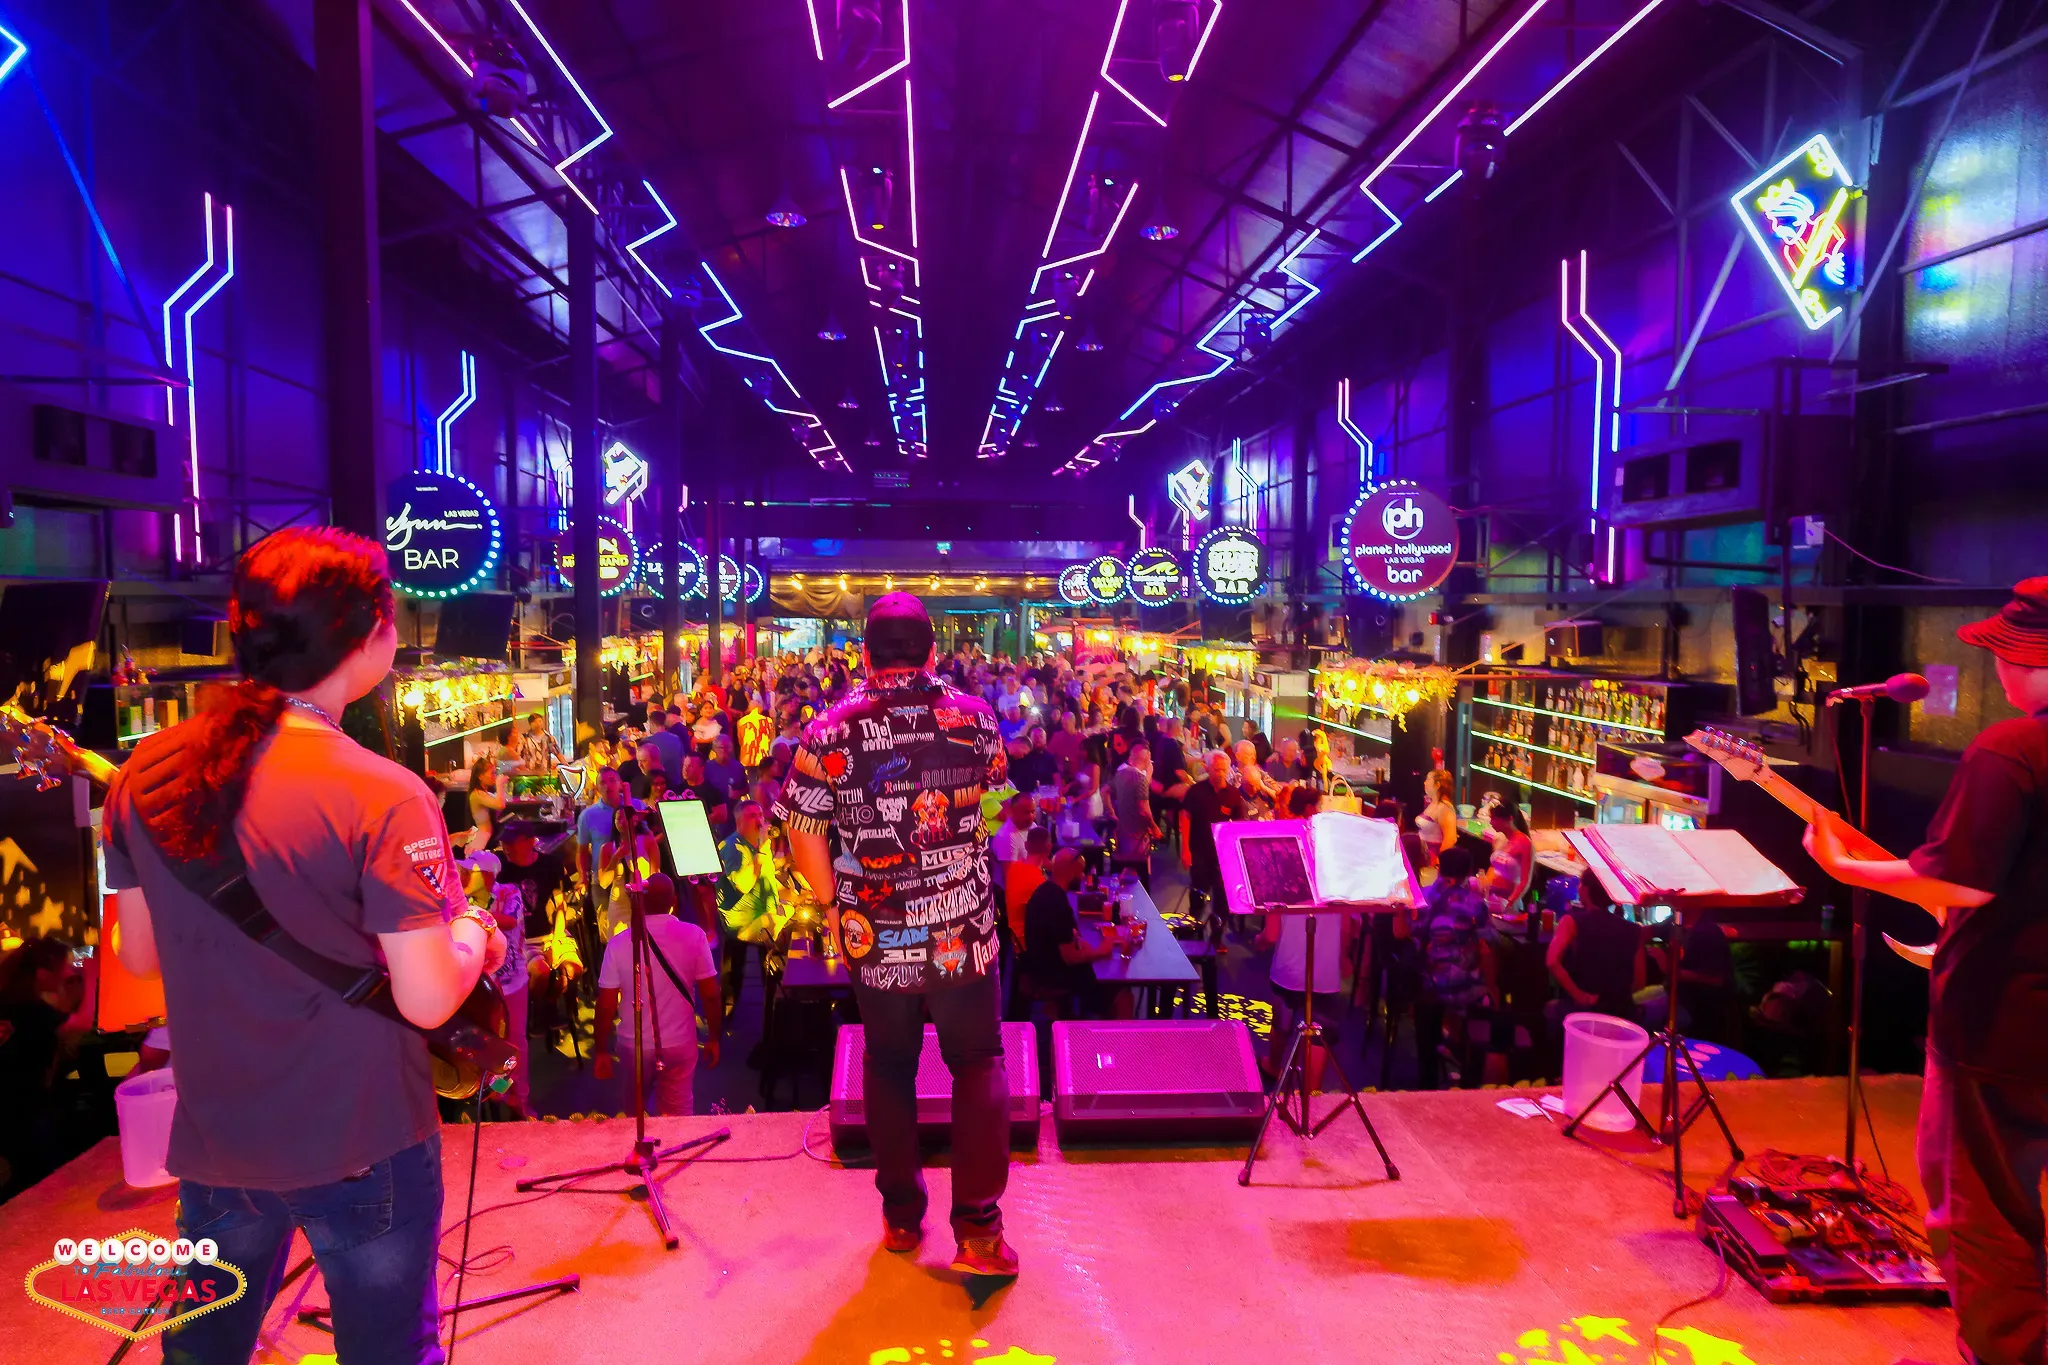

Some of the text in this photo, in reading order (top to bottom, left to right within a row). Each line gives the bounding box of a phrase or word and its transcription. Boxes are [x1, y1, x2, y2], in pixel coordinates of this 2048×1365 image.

[444, 509, 480, 518] LAS VEGAS
[1386, 498, 1424, 537] ph
[404, 548, 460, 570] BAR
[1355, 543, 1452, 558] planet hollywood
[599, 554, 629, 567] RAND
[1387, 565, 1423, 583] bar
[1214, 580, 1250, 594] BAR
[859, 717, 888, 739] The
[883, 780, 921, 794] Rainbow
[403, 837, 438, 854] SPEED
[852, 822, 906, 855] METALLICA
[910, 828, 953, 850] QUEEN
[894, 879, 921, 891] PLACEBO
[904, 878, 980, 927] SCORPIONS
[877, 926, 929, 949] SLADE
